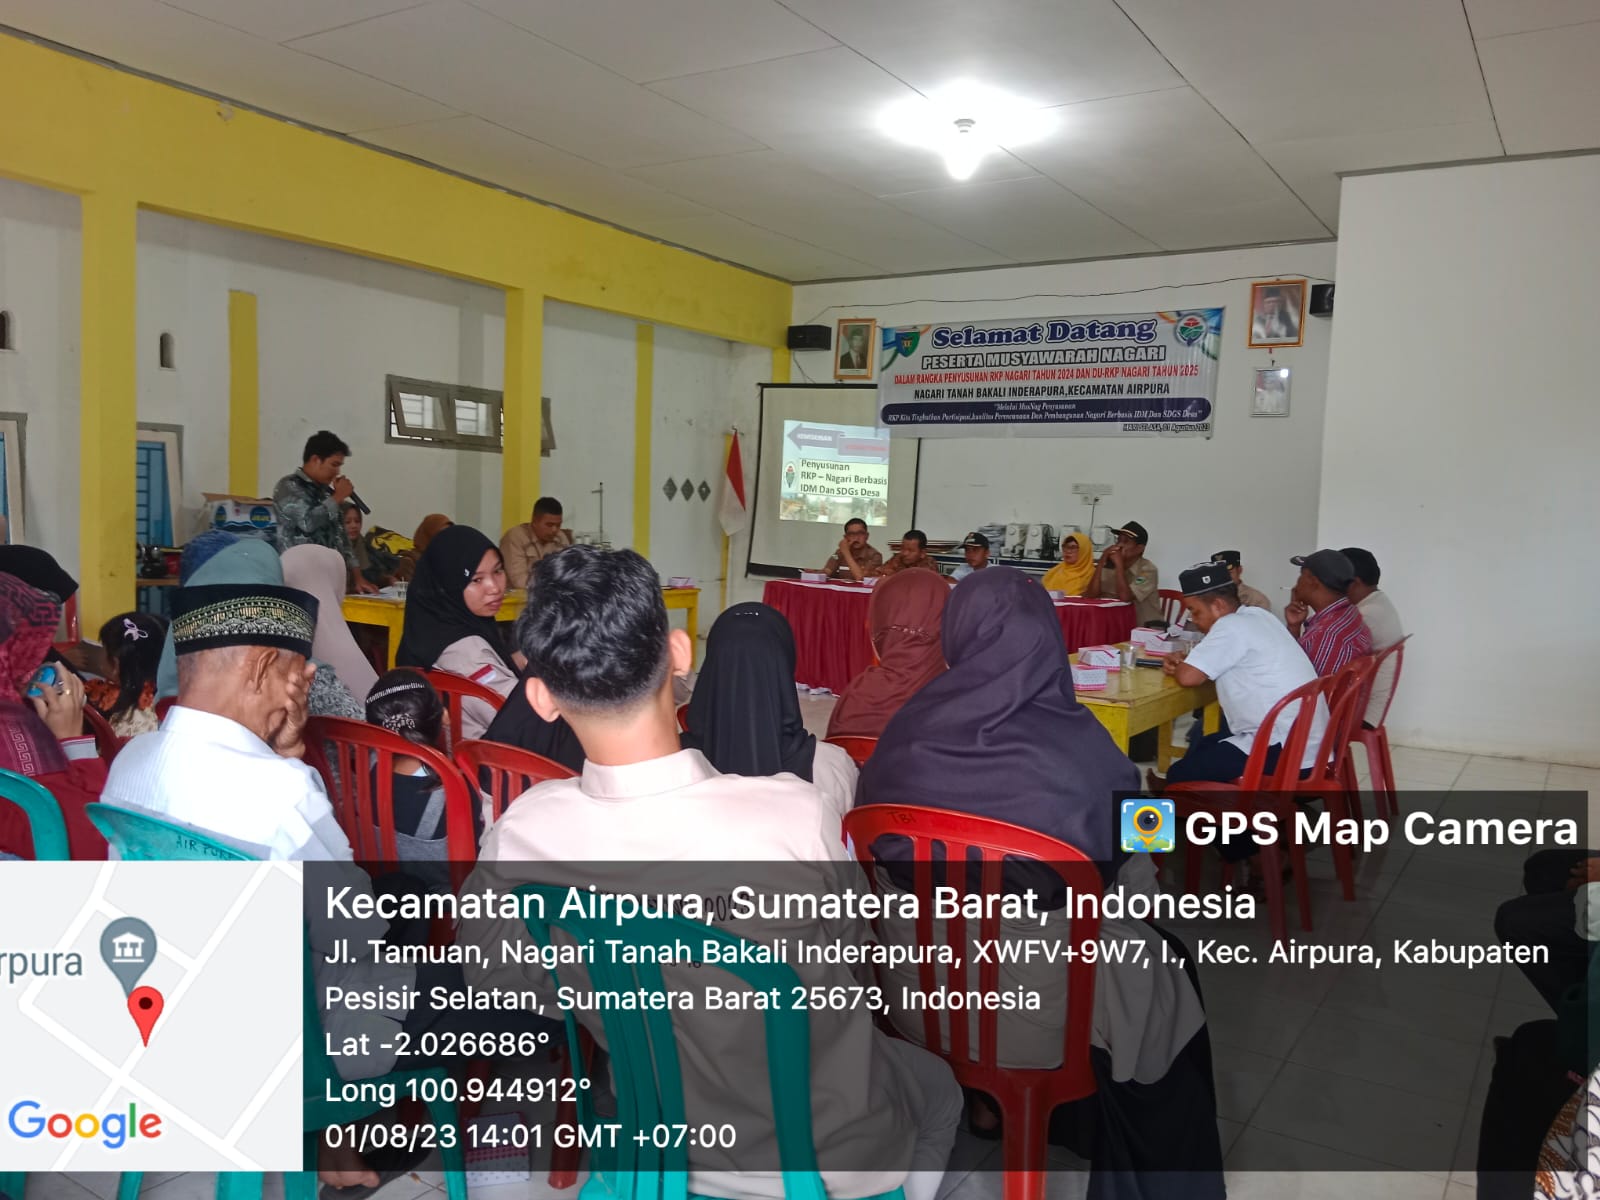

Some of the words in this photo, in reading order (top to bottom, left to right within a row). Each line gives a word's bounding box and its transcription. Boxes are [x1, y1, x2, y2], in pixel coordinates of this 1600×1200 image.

[932, 323, 1043, 349] Selamat
[1046, 319, 1157, 344] Datang
[922, 353, 984, 370] PESERTA
[986, 348, 1099, 368] MUSYAWARAH
[1100, 346, 1166, 363] NAGARI
[895, 375, 915, 385] DALAM
[917, 374, 943, 385] RANGKA
[944, 372, 988, 383] PENYUSUNAN
[989, 371, 1003, 382] RKP
[1005, 370, 1031, 381] NAGARI
[1032, 369, 1056, 380] TAHUN
[1057, 368, 1074, 380] 2024
[1076, 368, 1090, 379] DAN
[1092, 367, 1119, 378] DU-RKP
[1122, 366, 1150, 377] NAGARI
[1152, 365, 1177, 376] TAHUN
[1180, 364, 1199, 376] 2025
[914, 388, 944, 399] NAGARI
[947, 388, 974, 398] TANAH
[976, 387, 1006, 398] BAKALI
[1126, 383, 1170, 394] AIRPURA
[801, 460, 850, 470] Penyusunan
[801, 471, 817, 480] RKP
[825, 473, 852, 484] Nagari
[854, 475, 888, 485] Berbasis
[800, 484, 817, 493] IDM
[819, 485, 835, 494] Dan
[836, 486, 859, 495] SDGs
[860, 488, 880, 497] Desa
